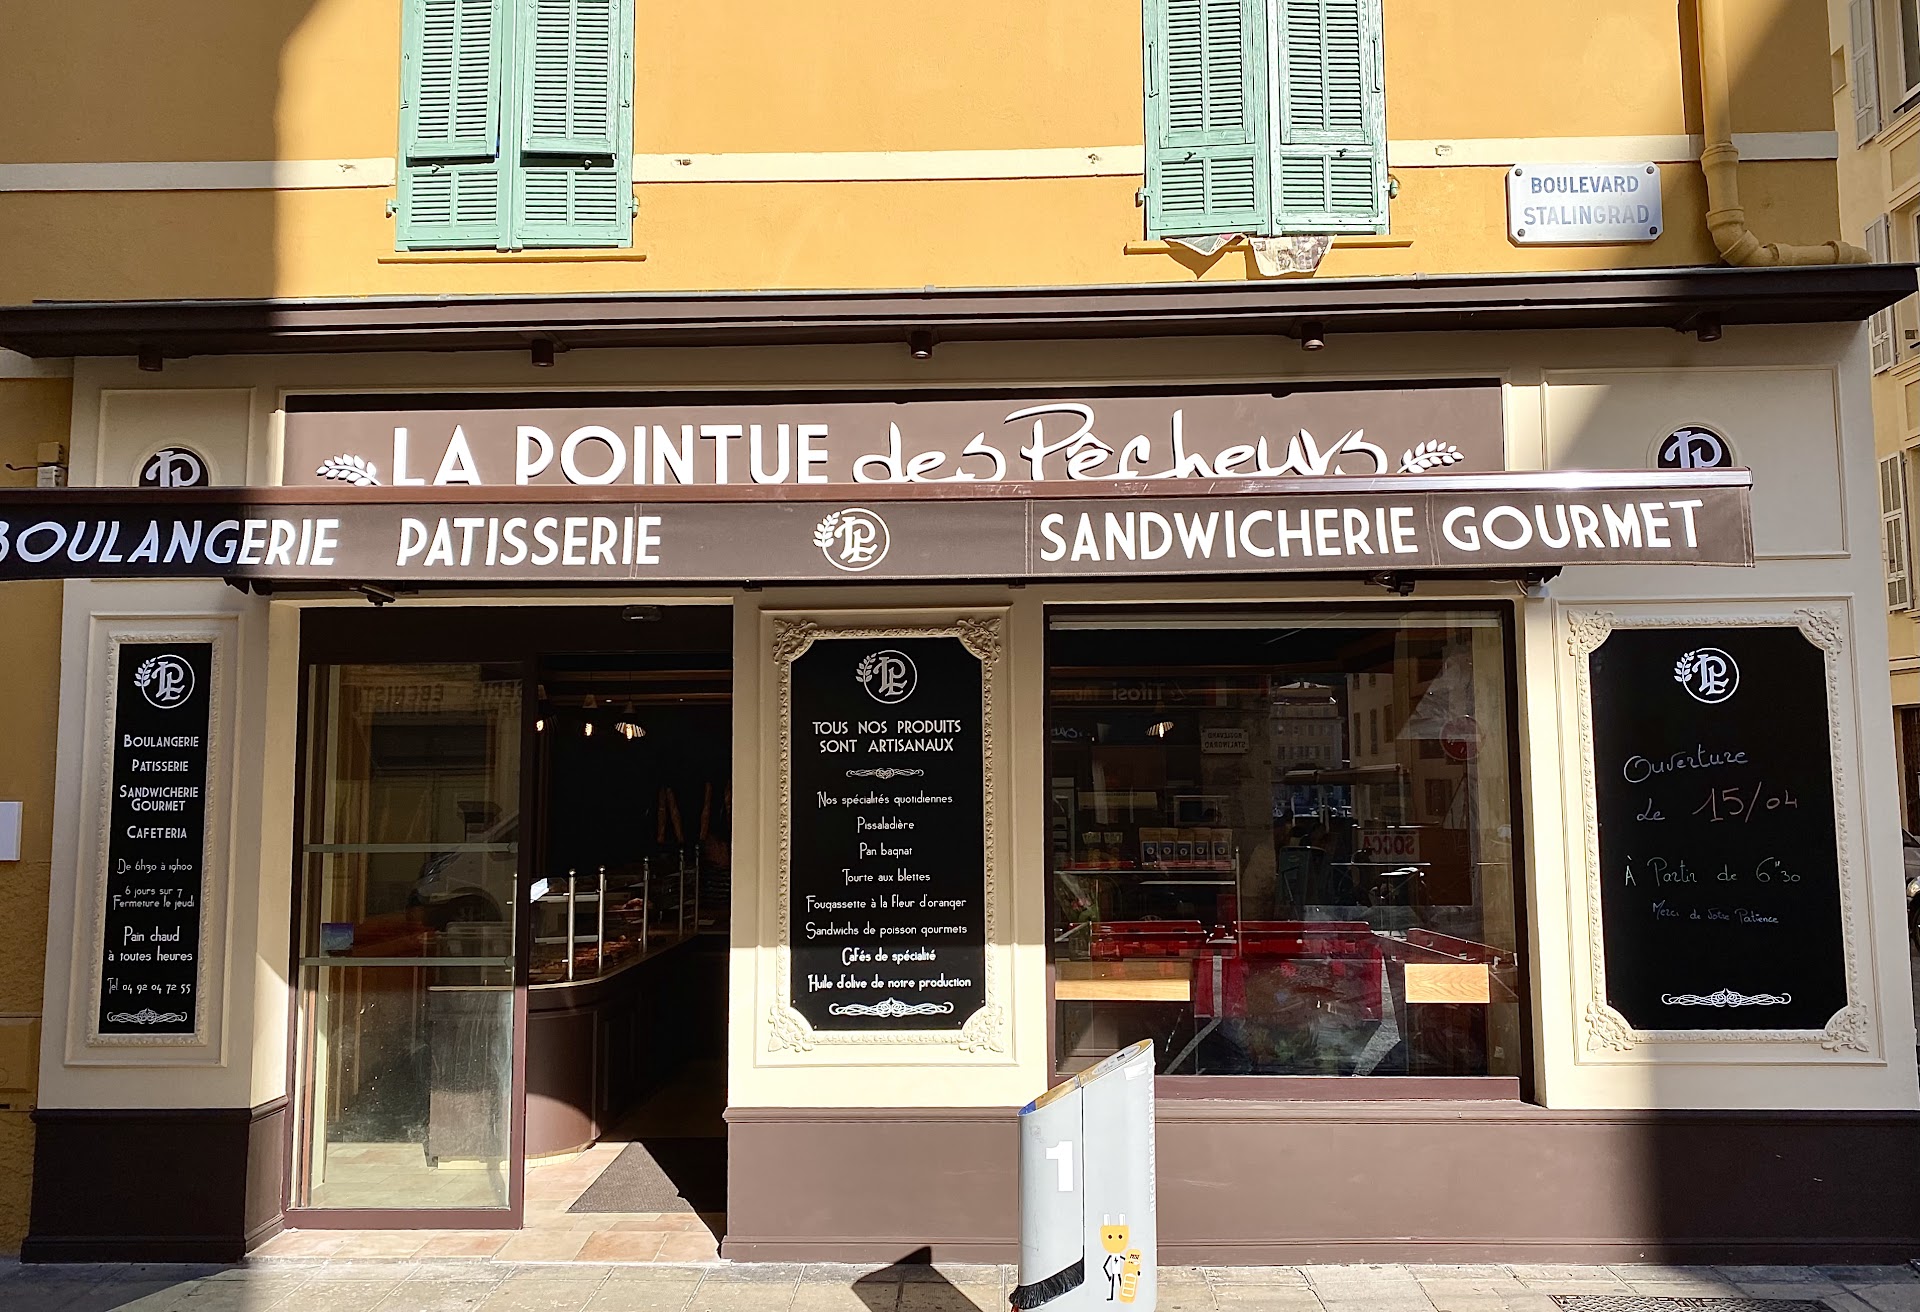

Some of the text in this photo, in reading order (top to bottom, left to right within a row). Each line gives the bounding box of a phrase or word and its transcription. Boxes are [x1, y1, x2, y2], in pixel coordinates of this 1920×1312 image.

[1531, 175, 1639, 194] BOULEVARD
[1524, 204, 1650, 226] STALINGRAD
[394, 425, 482, 486] LA
[515, 424, 829, 486] POINTUE
[852, 420, 1006, 483] des
[1039, 499, 1704, 563] SANDWICHERIE GOURMET
[397, 516, 662, 567] PATISSERIE
[812, 719, 961, 735] TOUS NOS PRODUITS
[123, 734, 199, 748] BOULANGERIE
[819, 738, 954, 754] SONT ARTISANAUX
[132, 759, 188, 772] PATISSERIE
[1623, 744, 1749, 783] Ouverture
[119, 784, 199, 798] SANDWICHERIE
[816, 790, 953, 808] Nos spécialités quotidiennes
[131, 798, 186, 811] GOURMET
[1692, 781, 1798, 823] 15/04
[127, 825, 187, 839] CAFETERIA
[857, 816, 915, 833] Pissaladière
[860, 842, 913, 859] Pan bagnat
[116, 858, 193, 874] De 6h30 à 19h00
[1647, 857, 1697, 887] Partir
[1717, 864, 1737, 882] de
[842, 868, 931, 886] Tourte aux blettes
[125, 885, 131, 895] 6
[134, 887, 156, 898] jours
[177, 888, 183, 898] 7
[113, 895, 195, 910] Fermeture le jeudi
[806, 894, 967, 913] Fougassette à la fleur d'oranger
[1652, 899, 1680, 920] Merci
[1690, 909, 1701, 920] de
[1734, 909, 1779, 924] Patience
[124, 925, 180, 946] Pain chaud
[805, 921, 967, 939] Sandwichs de poisson gourmets
[108, 945, 193, 961] à toutes heures
[842, 946, 936, 966] Cafés de spécialité
[106, 977, 191, 994] Tel 04 92 04 72 55
[807, 974, 833, 992] Huile
[870, 973, 885, 988] de
[887, 976, 915, 988] notre
[918, 973, 972, 992] production
[1045, 1140, 1074, 1192] 1
